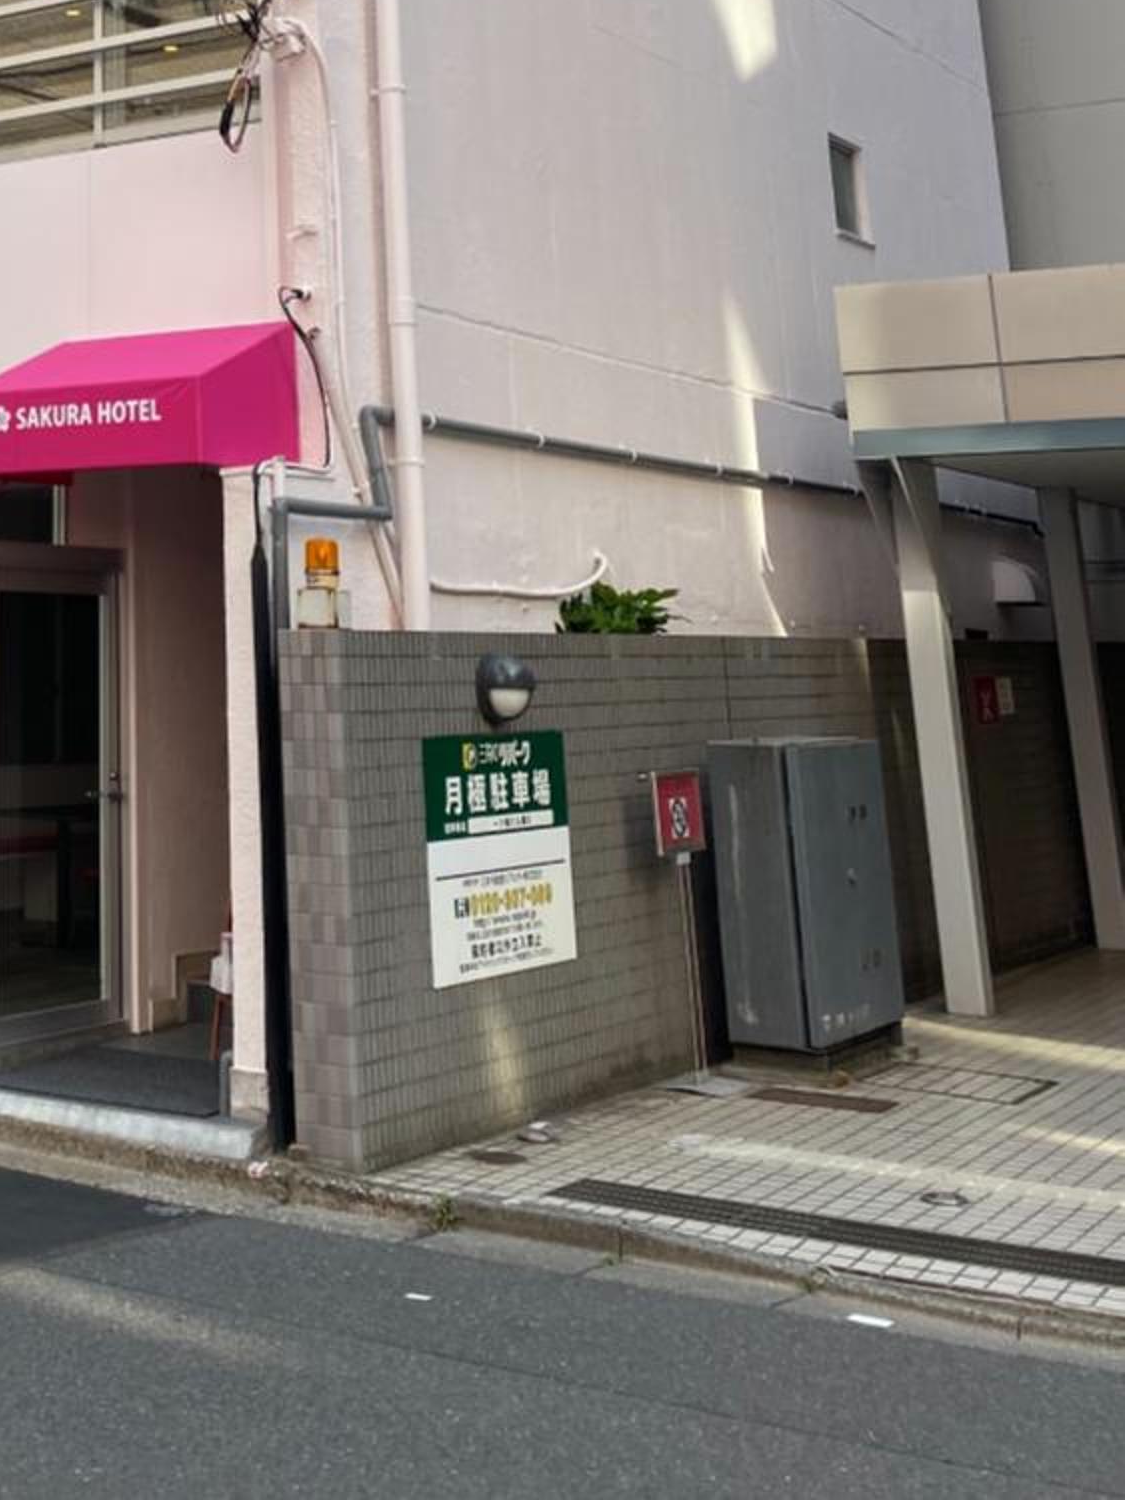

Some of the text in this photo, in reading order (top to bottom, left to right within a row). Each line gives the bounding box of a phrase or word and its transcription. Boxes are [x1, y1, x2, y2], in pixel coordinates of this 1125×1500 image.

[15, 398, 162, 431] SAKURA HOTEL
[445, 768, 551, 816] 月極駐車場
